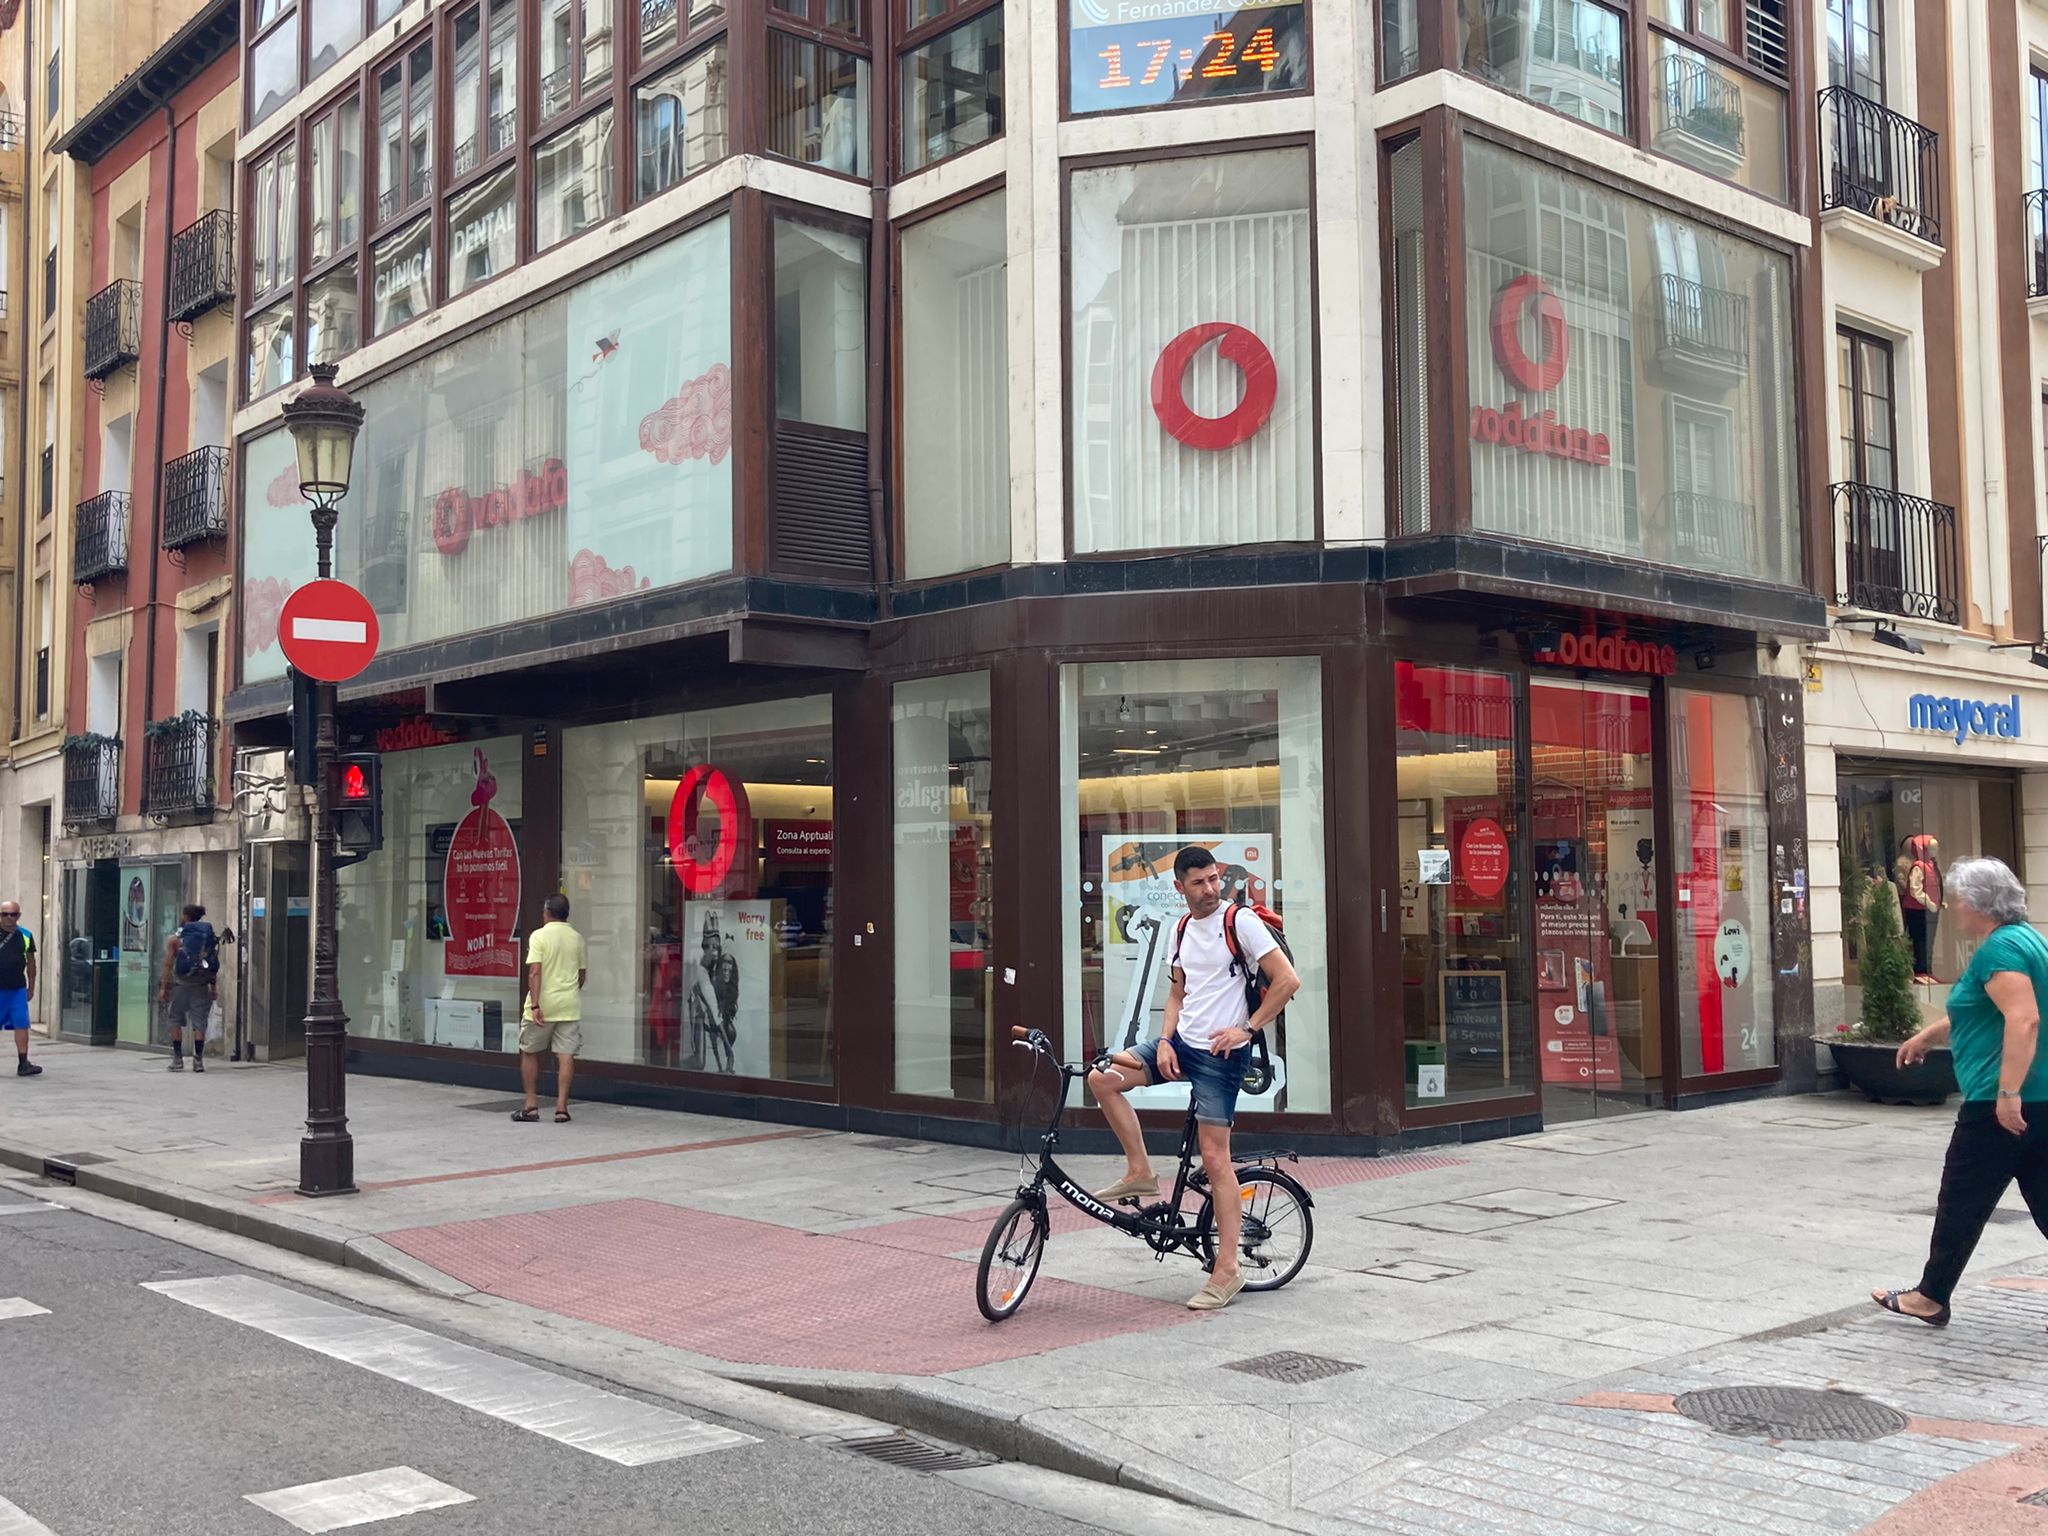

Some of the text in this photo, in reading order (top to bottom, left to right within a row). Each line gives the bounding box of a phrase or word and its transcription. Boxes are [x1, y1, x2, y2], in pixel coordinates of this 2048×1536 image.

[1098, 27, 1280, 89] 17:24
[454, 201, 517, 260] DENTAL
[471, 458, 568, 530] vodafo
[1538, 624, 1677, 675] odafone
[1907, 693, 2021, 747] mayoral
[776, 829, 834, 842] Zona Apptuali
[776, 846, 802, 855] Consulta
[738, 911, 766, 926] Worry
[1548, 921, 1567, 929] mejor
[467, 935, 485, 952] NON
[746, 928, 765, 941] free
[1740, 1028, 1758, 1050] 24
[1060, 1180, 1115, 1219] moma
